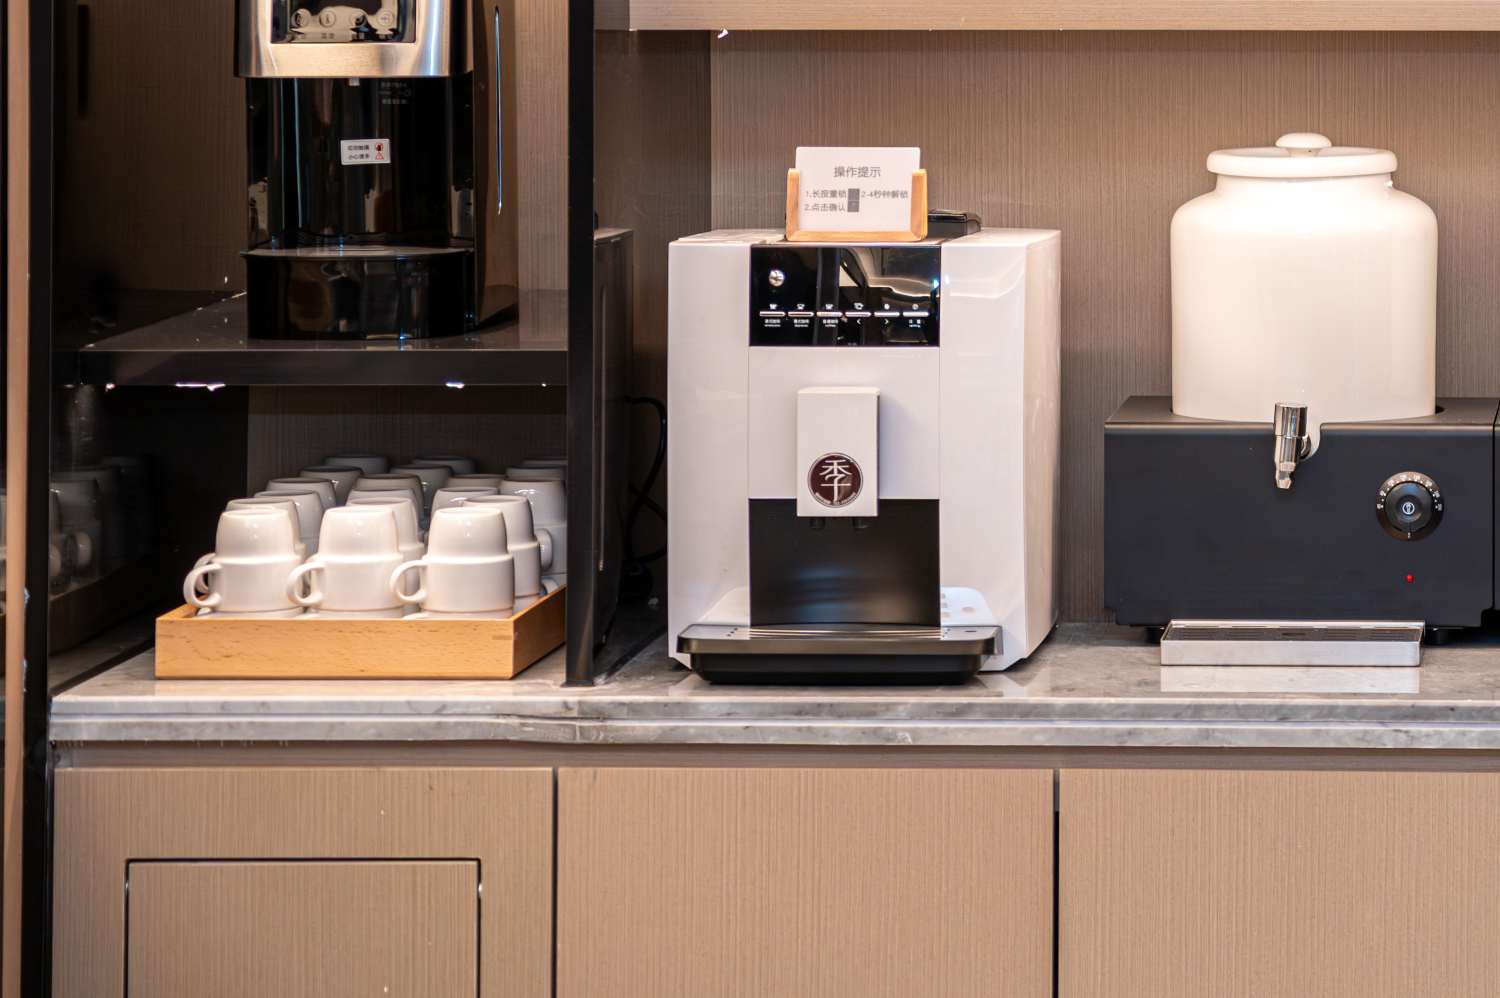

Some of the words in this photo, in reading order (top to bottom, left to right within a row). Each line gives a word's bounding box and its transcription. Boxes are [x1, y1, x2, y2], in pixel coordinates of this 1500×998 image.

[833, 166, 881, 178] 操作提示
[804, 203, 847, 212] 2.点击确认
[819, 459, 853, 502] 季
